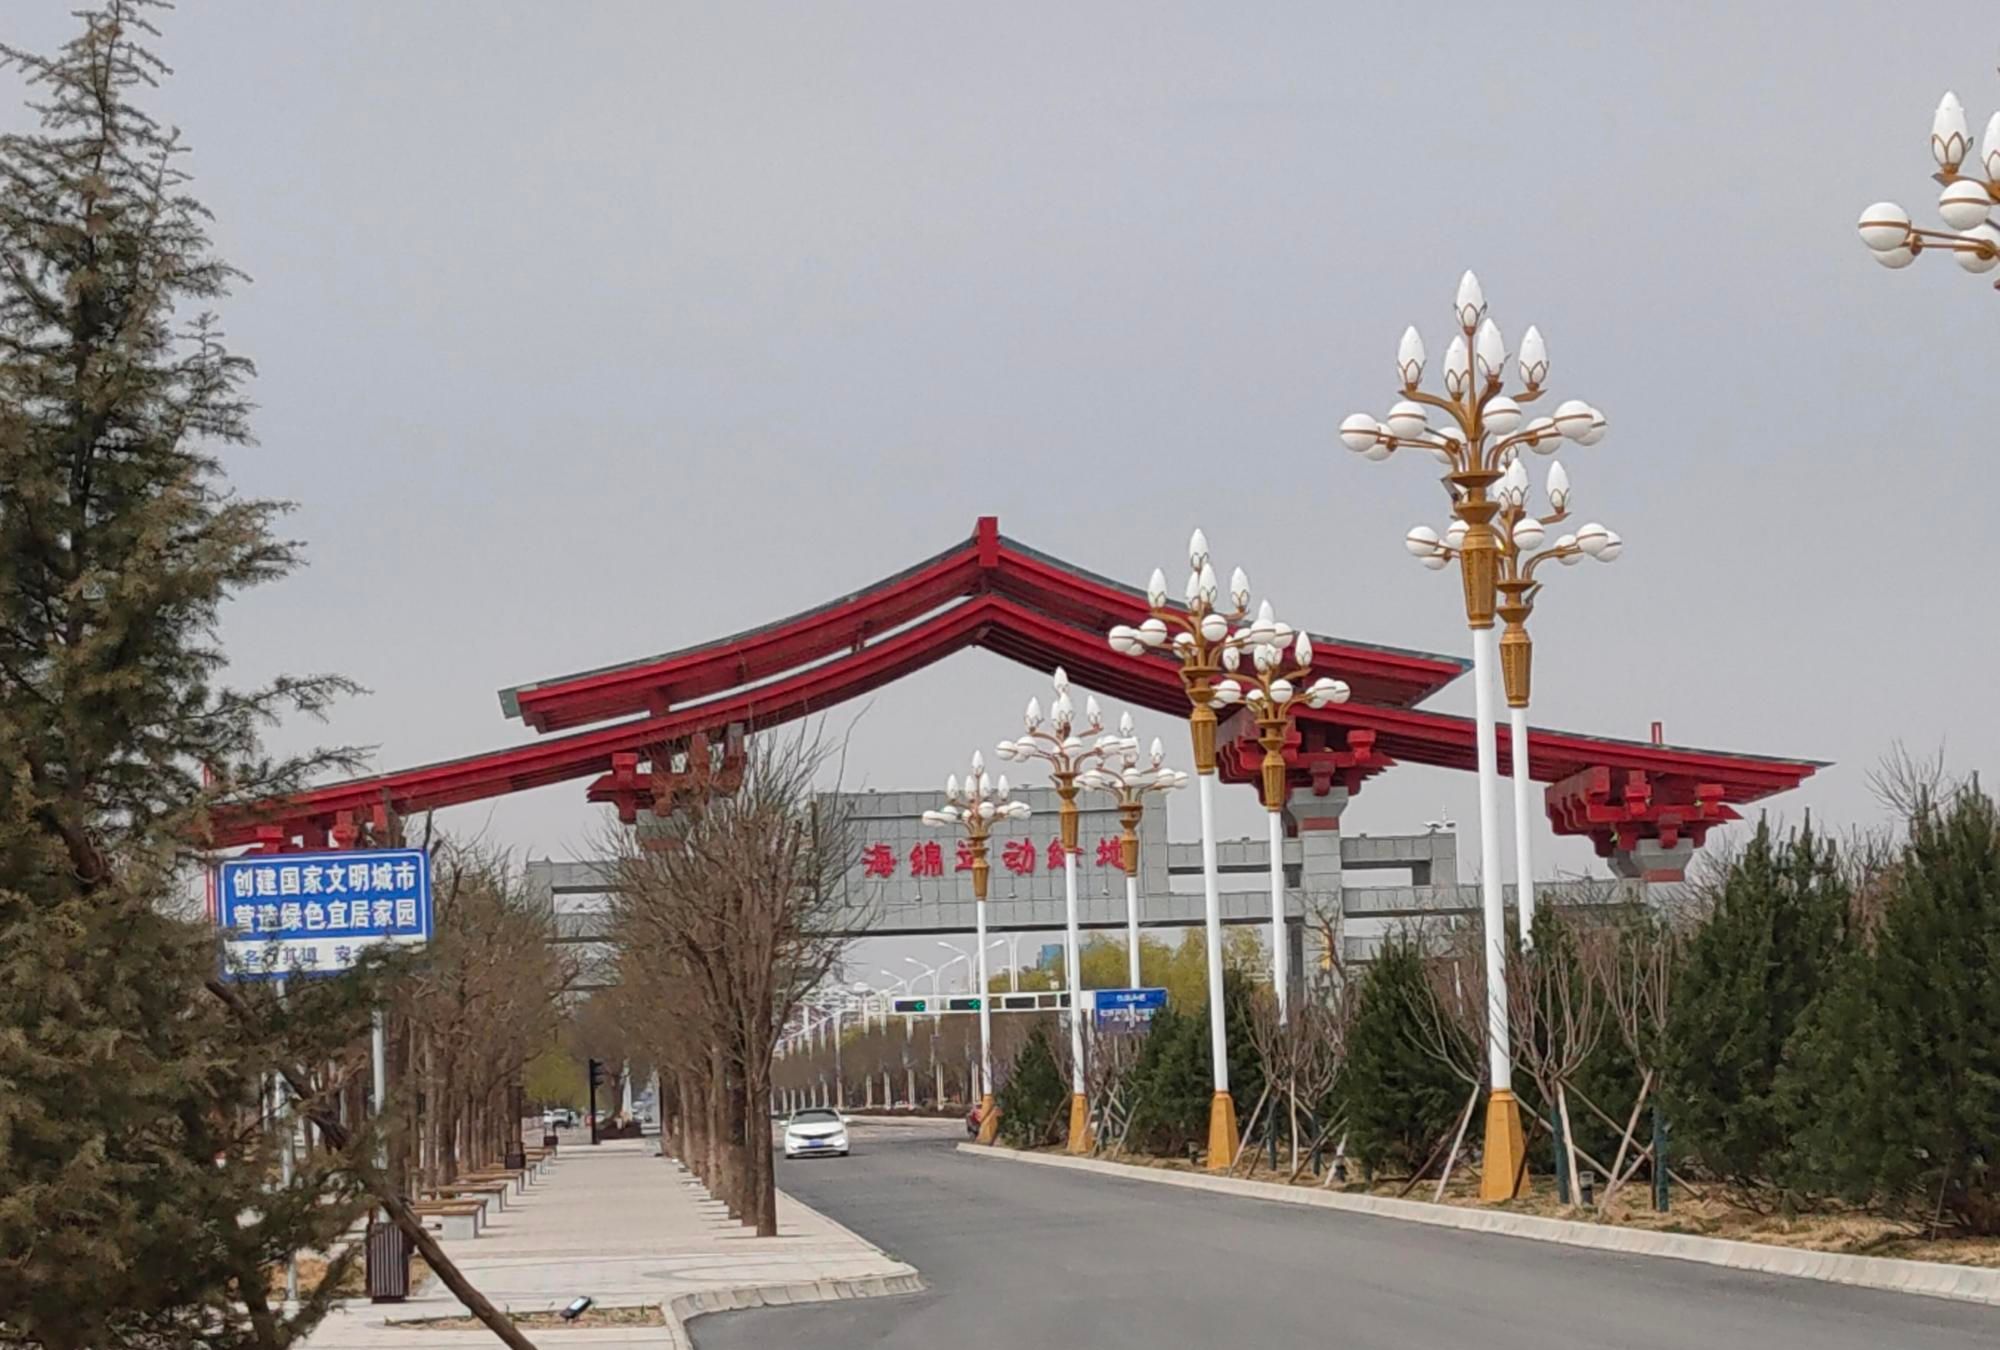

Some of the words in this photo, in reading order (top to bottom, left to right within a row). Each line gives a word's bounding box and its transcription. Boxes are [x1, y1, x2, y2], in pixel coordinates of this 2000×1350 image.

[233, 861, 417, 898] 创建国家文明城市
[233, 898, 417, 933] 营造绿色宜居家园
